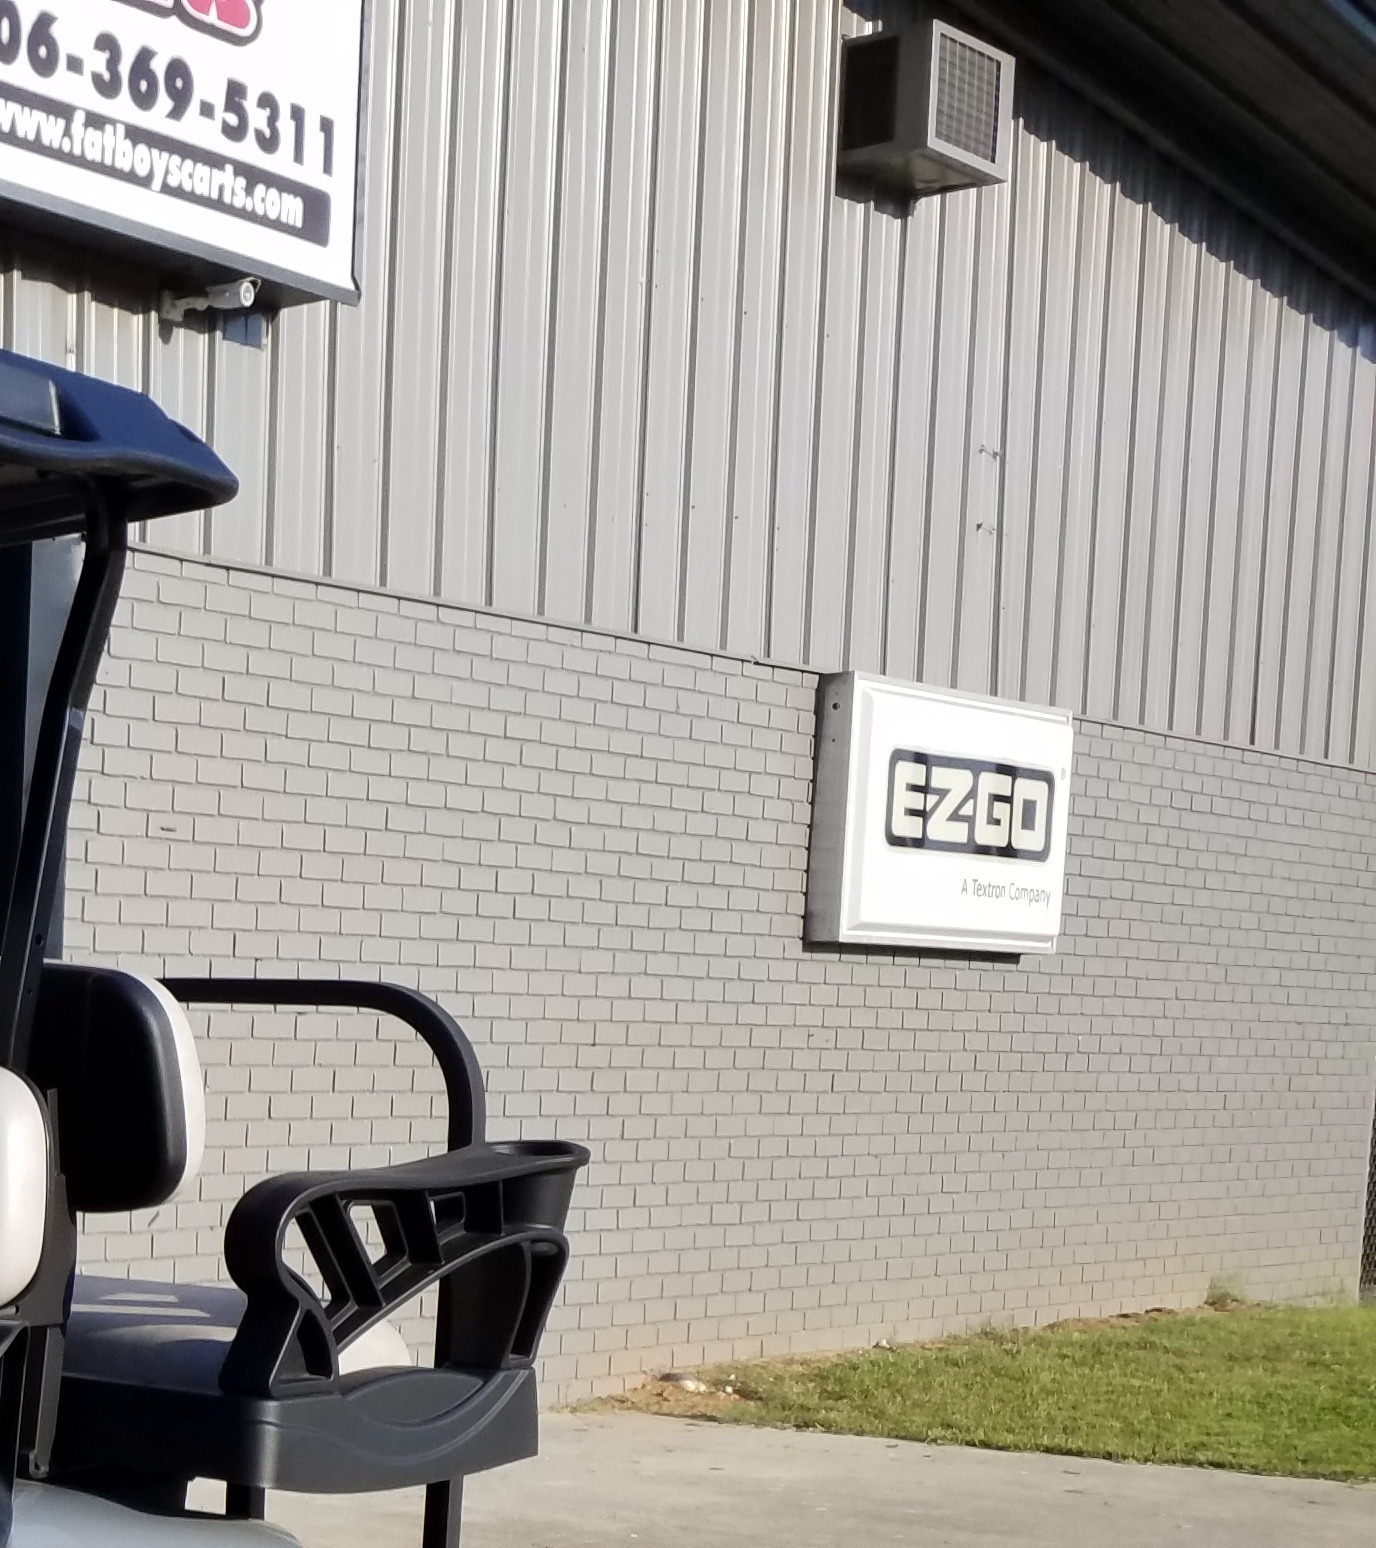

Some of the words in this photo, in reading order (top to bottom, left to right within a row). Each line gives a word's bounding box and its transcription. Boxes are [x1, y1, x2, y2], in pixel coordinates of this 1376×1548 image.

[890, 760, 1049, 852] EZGO
[960, 877, 969, 896] A
[972, 878, 1006, 899] Textron
[1009, 882, 1051, 908] Company
